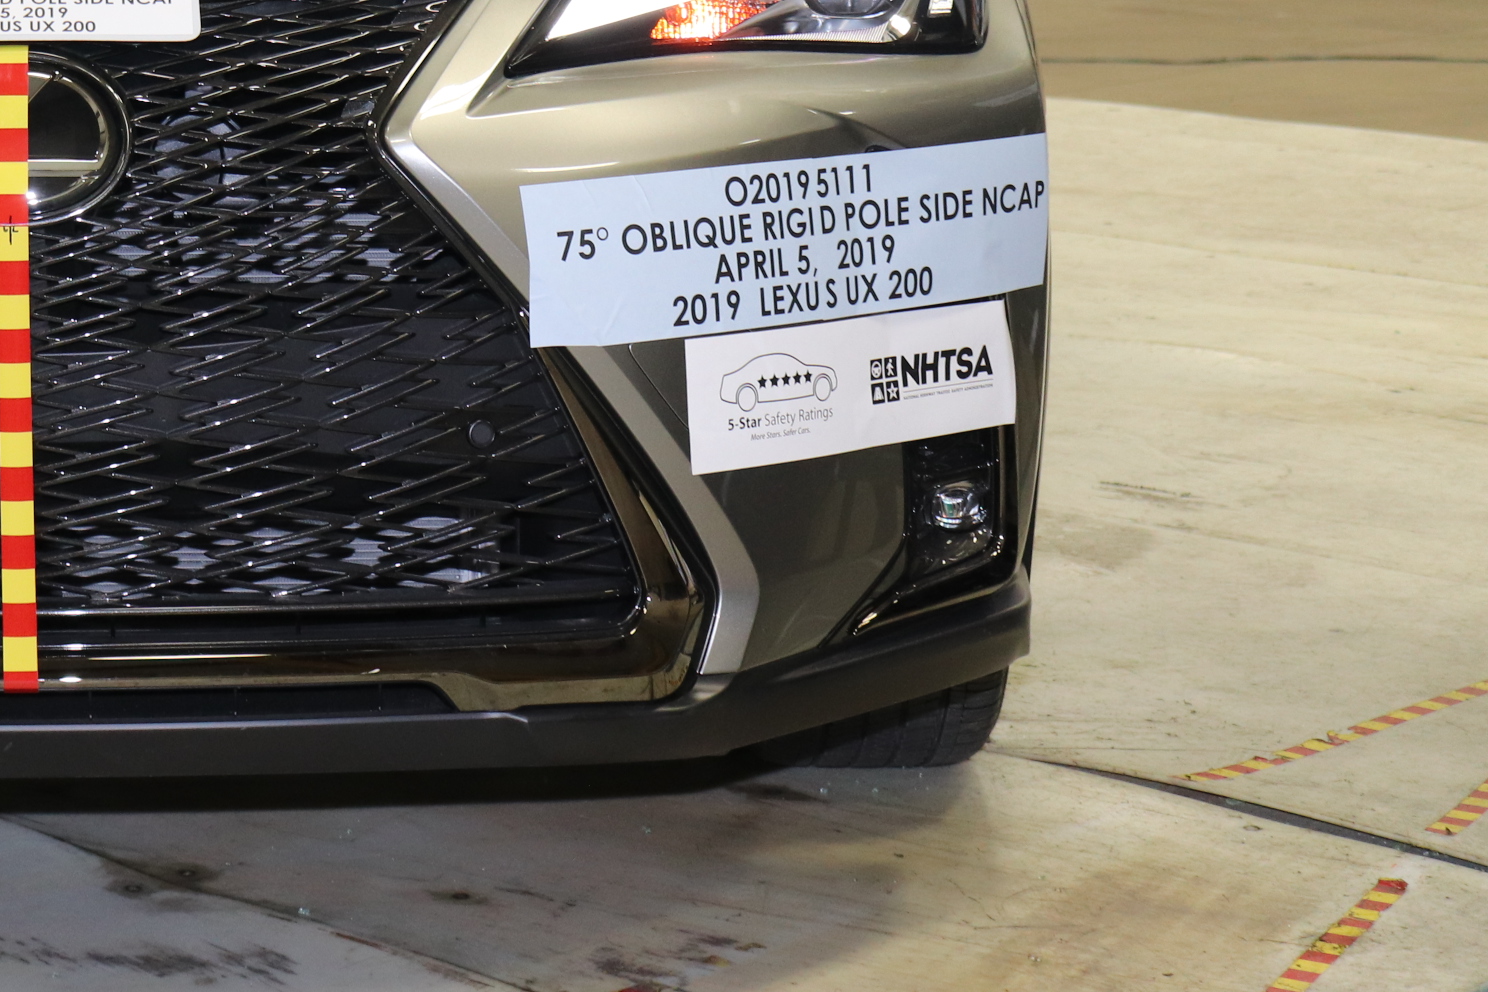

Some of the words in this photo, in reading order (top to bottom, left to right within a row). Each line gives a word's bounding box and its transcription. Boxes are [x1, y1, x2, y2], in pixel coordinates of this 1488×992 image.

[0, 7, 16, 20] 5,
[23, 7, 68, 18] 2019
[30, 20, 55, 32] UX
[62, 20, 96, 32] 200
[556, 226, 609, 262] 75°
[621, 213, 753, 255] OBLIQUE
[762, 205, 836, 241] RIGID
[844, 196, 909, 232] POLE
[919, 189, 973, 224] SIDE
[982, 180, 1044, 216] NCAP
[715, 247, 789, 284] APRIL
[797, 244, 818, 277] 5,
[837, 234, 895, 270] 2019
[673, 289, 740, 327] 2019
[760, 278, 837, 316] LEXUS
[846, 273, 879, 306] UX
[888, 266, 933, 300] 200
[901, 344, 993, 387] NHTSA
[728, 416, 762, 431] 5-Star
[764, 411, 796, 426] Safety
[799, 407, 834, 422] Ratings
[751, 433, 766, 441] More
[783, 428, 797, 437] Safer
